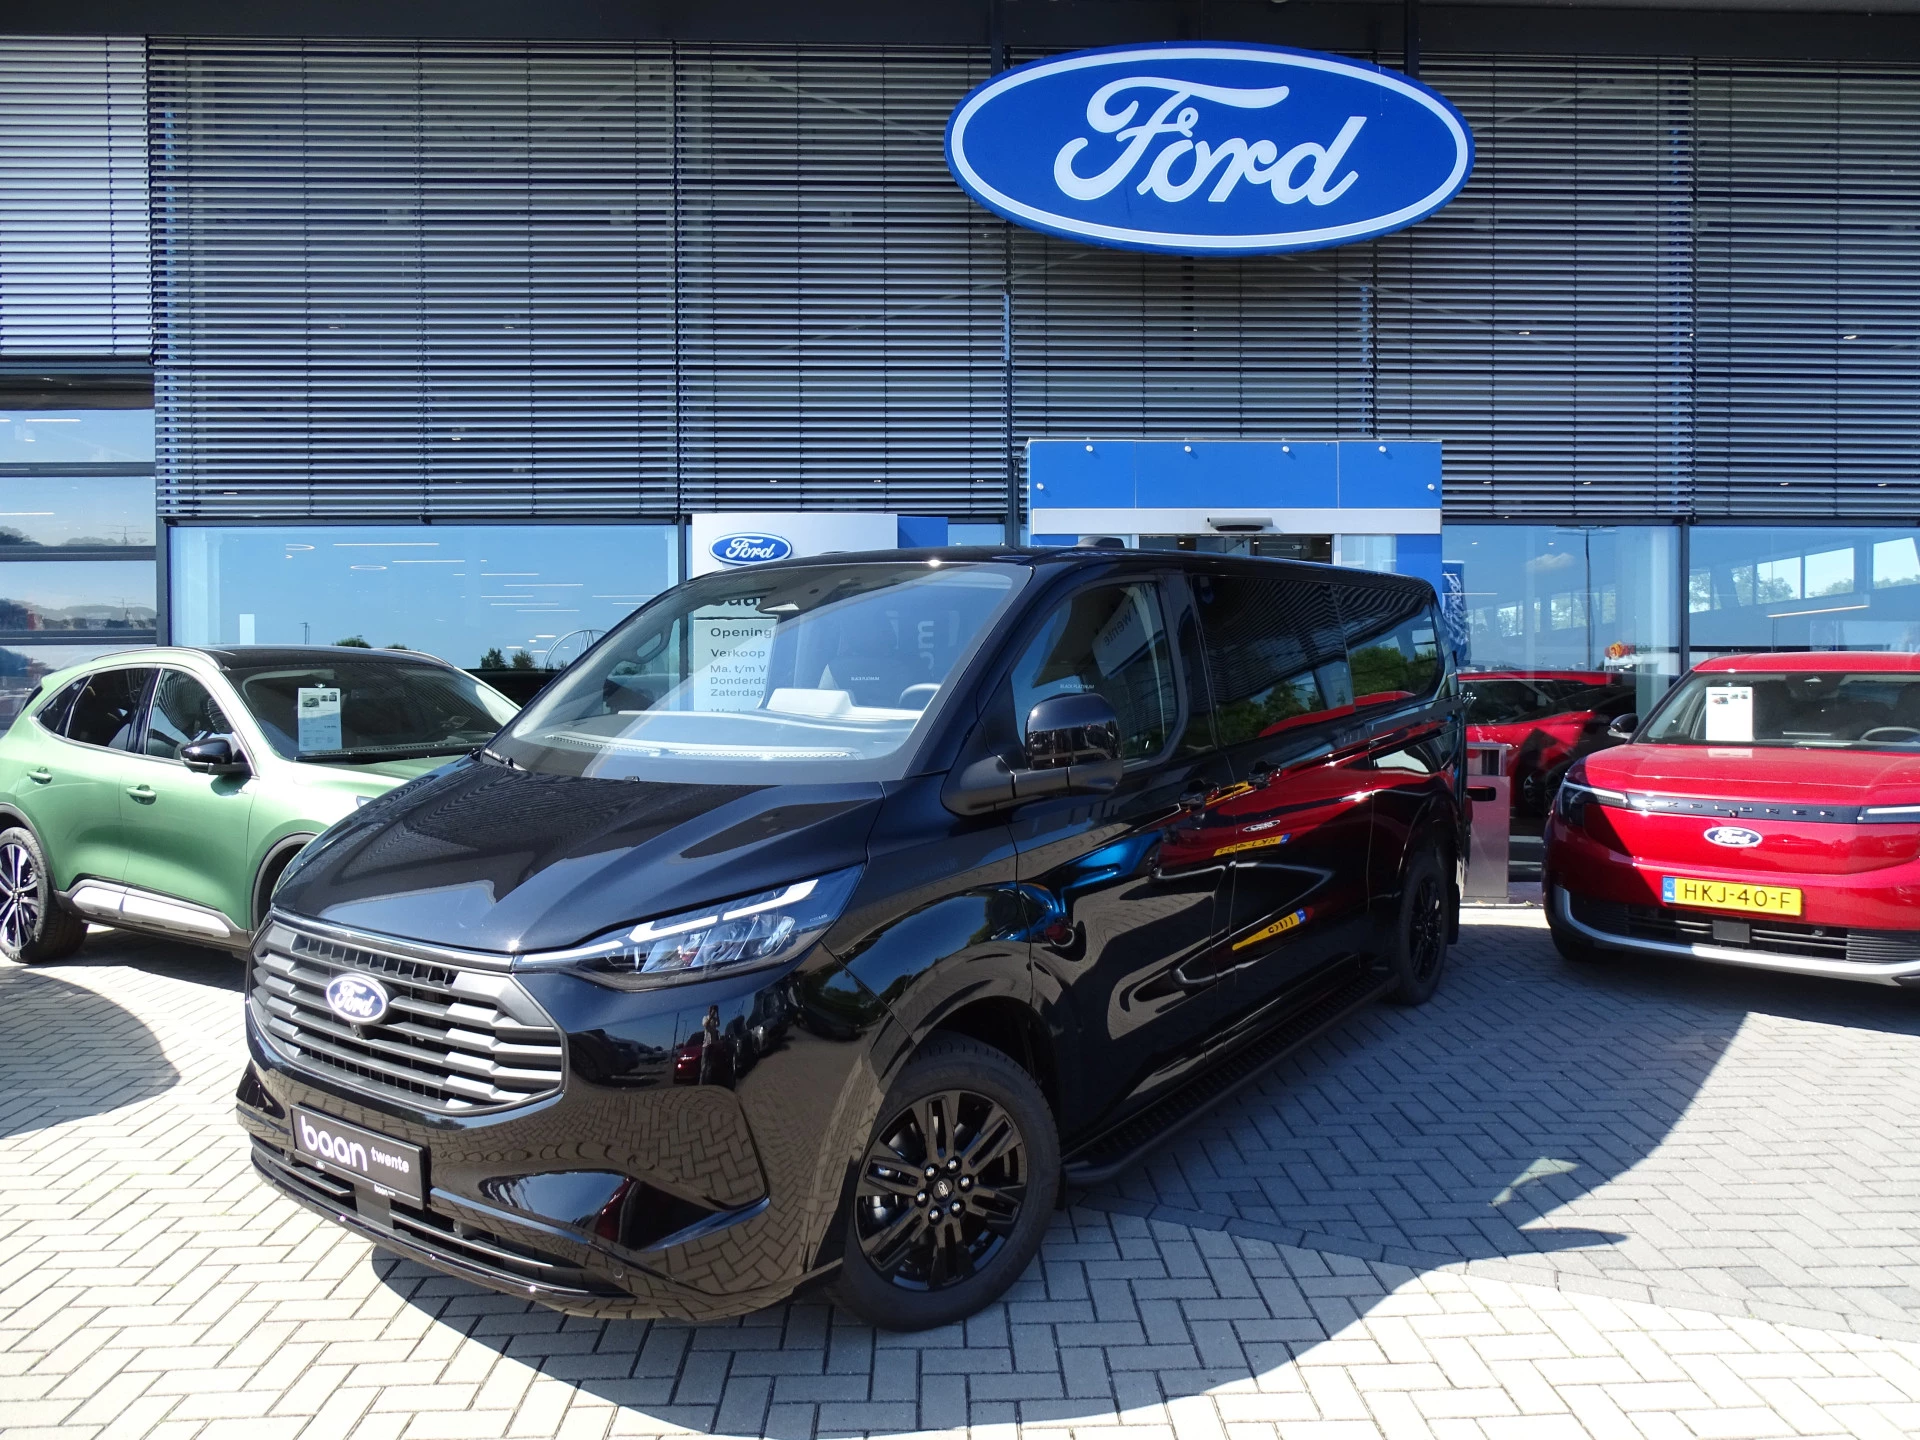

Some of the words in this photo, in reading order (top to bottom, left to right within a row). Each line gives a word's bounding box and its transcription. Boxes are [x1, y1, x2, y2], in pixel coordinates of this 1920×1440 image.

[1054, 77, 1367, 206] Ford
[725, 537, 776, 559] Ford
[710, 627, 772, 639] Opening
[710, 648, 766, 659] Verkoop
[710, 665, 732, 673] Ma.
[735, 665, 756, 673] t/m
[710, 689, 764, 698] Zaterdag
[1714, 829, 1752, 844] Ford
[1684, 882, 1791, 909] HKJ-40-F
[334, 980, 375, 1016] Ford
[300, 1115, 368, 1172] baan
[370, 1146, 410, 1174] twente
